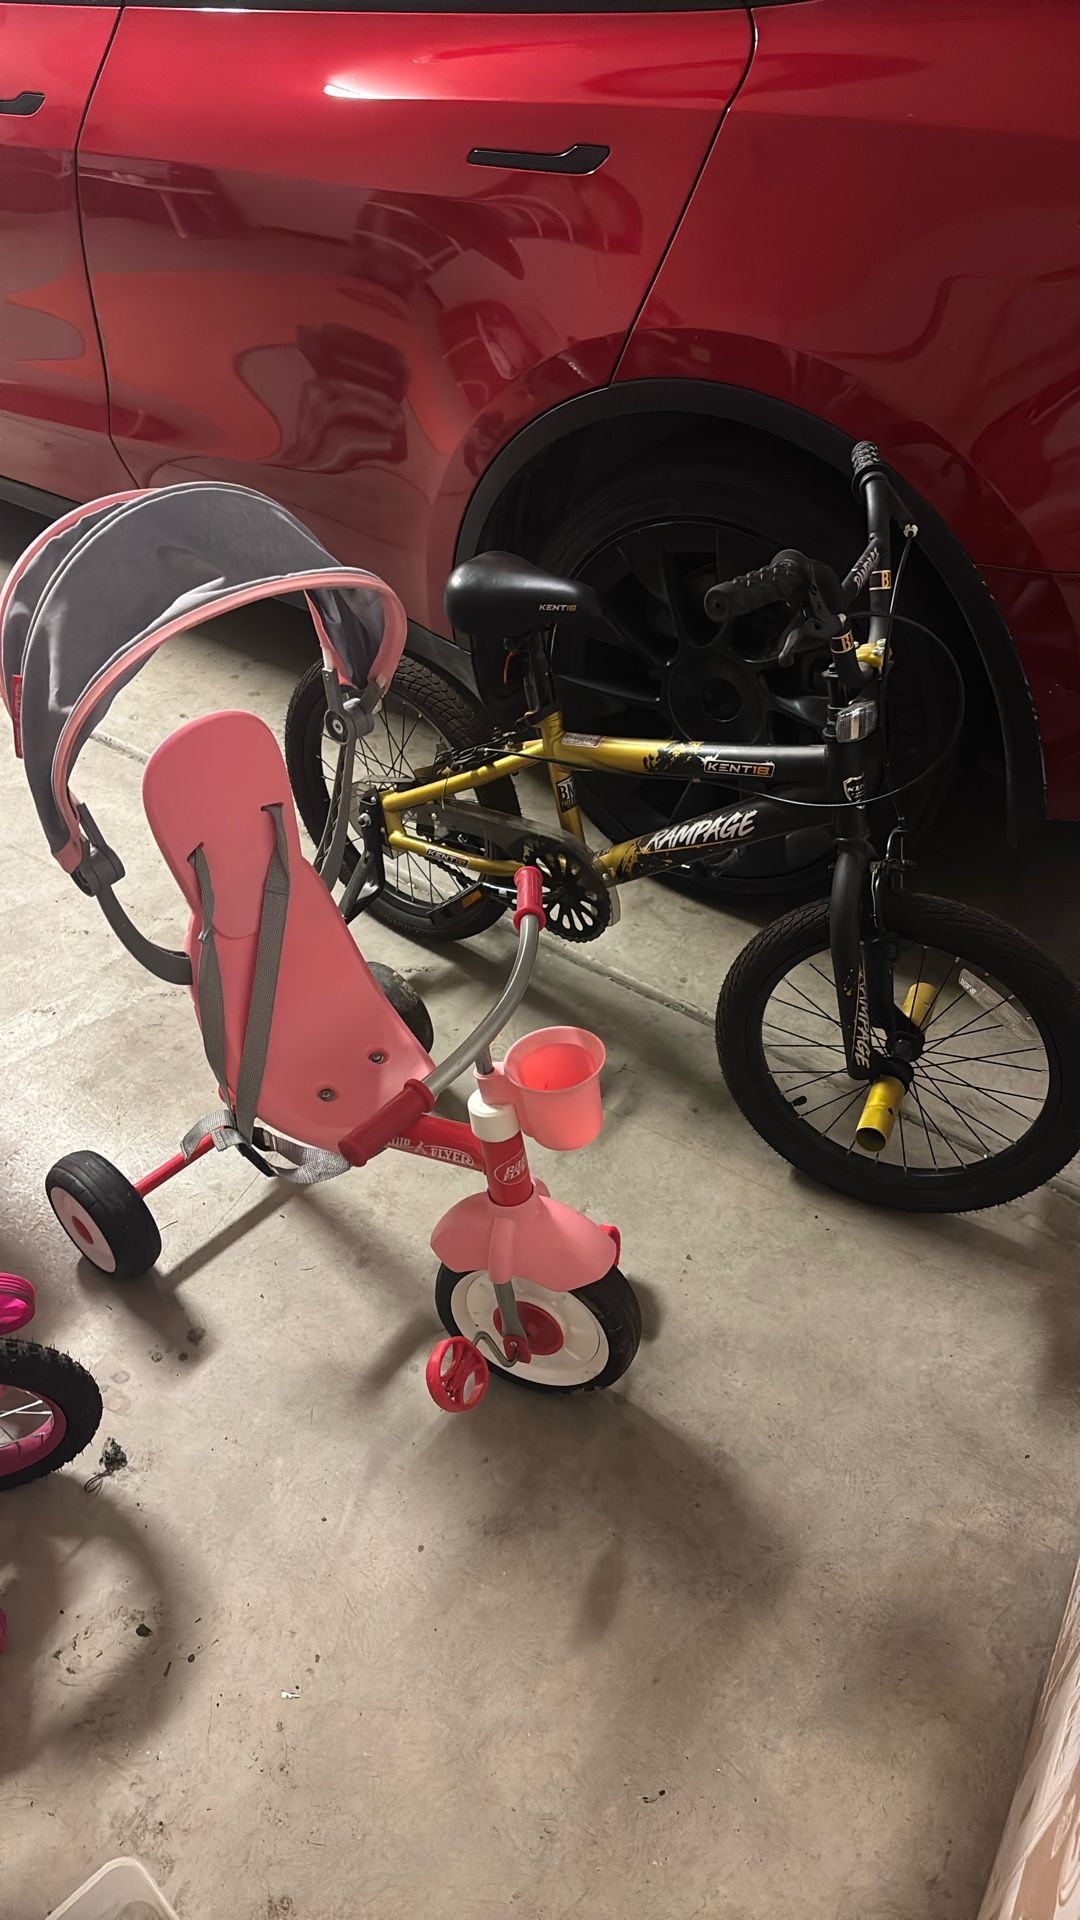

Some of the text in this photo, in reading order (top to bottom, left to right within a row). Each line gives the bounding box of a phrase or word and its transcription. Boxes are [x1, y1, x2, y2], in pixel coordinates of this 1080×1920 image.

[707, 762, 769, 775] KENT18
[645, 809, 758, 850] RAMPAGE
[430, 1147, 474, 1166] FLYER
